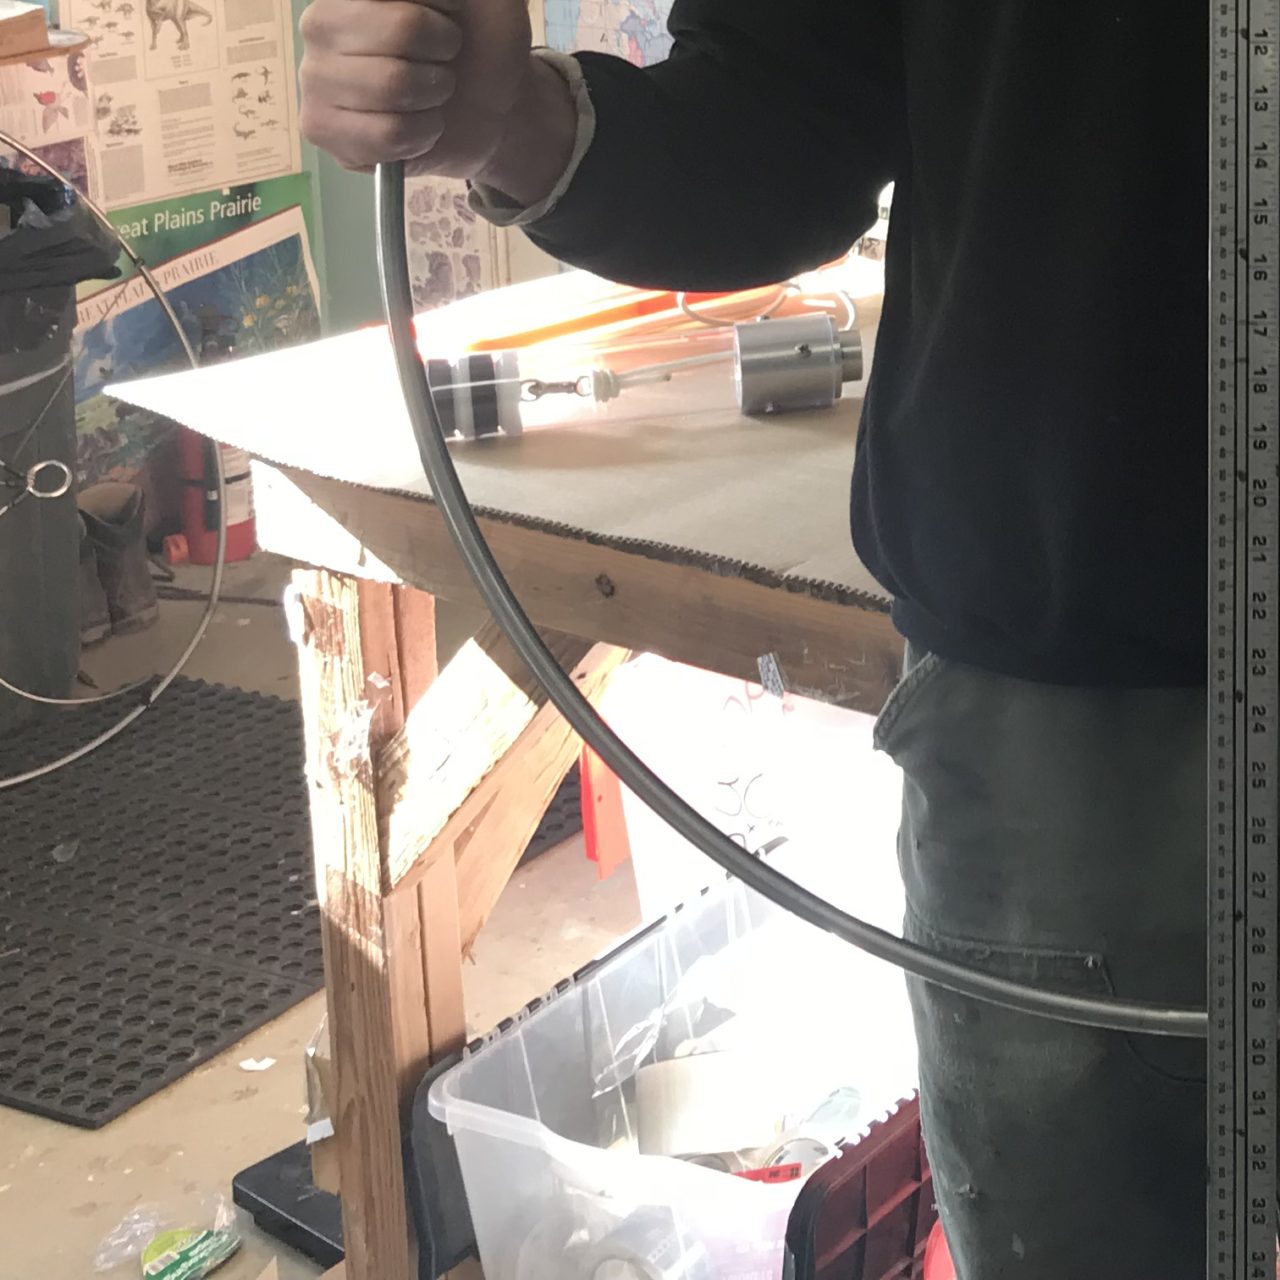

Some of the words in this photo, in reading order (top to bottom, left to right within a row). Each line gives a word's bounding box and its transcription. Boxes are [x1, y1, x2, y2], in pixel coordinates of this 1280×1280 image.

[1254, 29, 1268, 56] 12
[1254, 86, 1268, 112] 13
[1254, 142, 1268, 169] 14
[154, 207, 205, 233] Plains
[210, 192, 262, 221] Prairie
[1254, 198, 1268, 225] 15
[1253, 254, 1268, 281] 16
[1253, 310, 1268, 338] 17
[1253, 367, 1268, 394] 18
[1253, 423, 1267, 450] 19
[1253, 479, 1267, 508] 20
[1252, 536, 1266, 562] 21
[1252, 592, 1266, 620] 22
[1252, 648, 1266, 677] 23
[1252, 706, 1266, 734] 24
[1252, 762, 1266, 789] 25
[1252, 817, 1266, 845] 26
[1252, 872, 1266, 900] 27
[1252, 927, 1266, 954] 28
[1252, 982, 1266, 1010] 29
[1252, 1038, 1266, 1066] 30
[1252, 1092, 1266, 1116] 31
[1252, 1145, 1266, 1171] 32
[1252, 1198, 1266, 1225] 33
